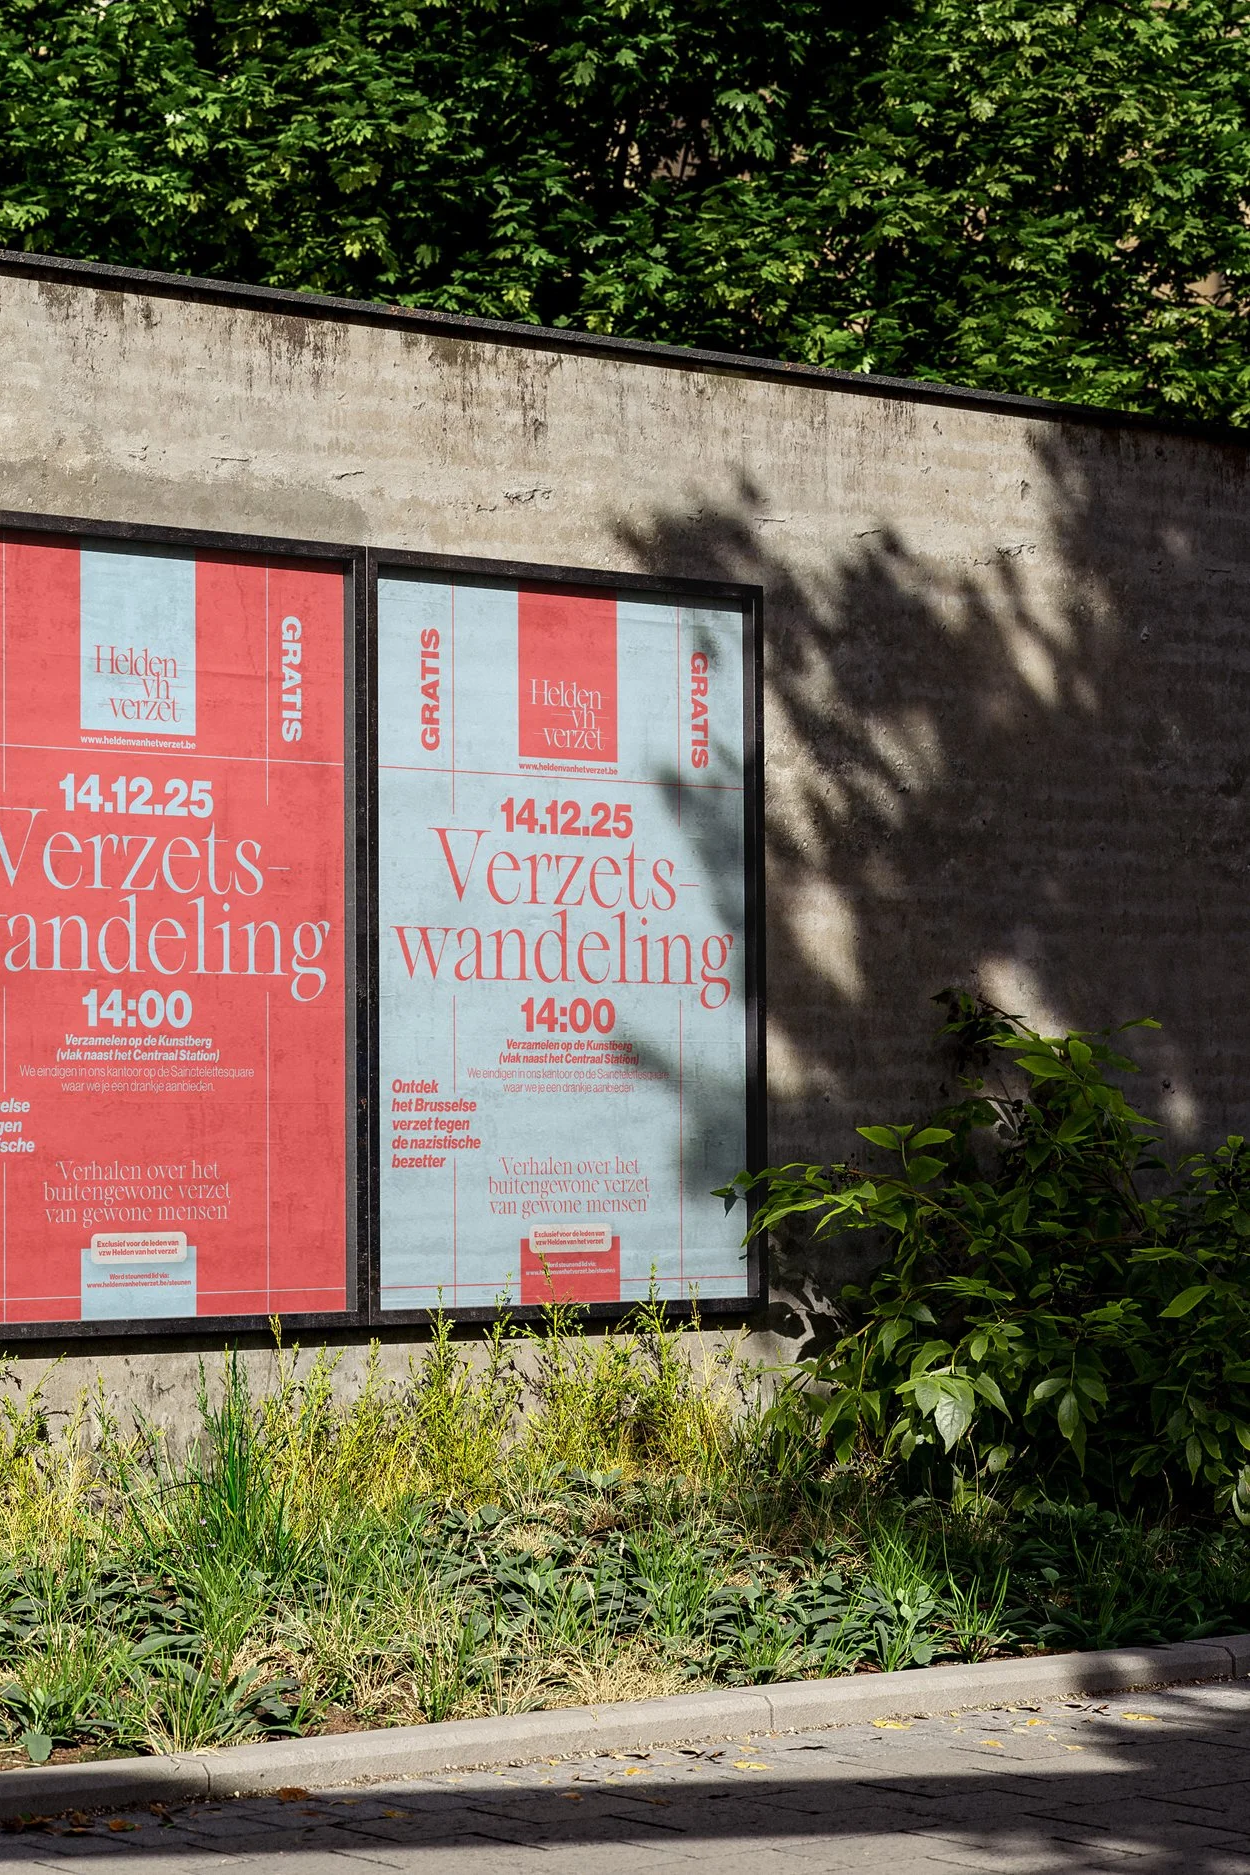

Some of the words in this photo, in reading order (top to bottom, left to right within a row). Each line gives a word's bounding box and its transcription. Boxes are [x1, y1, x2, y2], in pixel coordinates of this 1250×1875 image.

[95, 645, 180, 679] Helden
[281, 615, 303, 743] GRATIS
[420, 627, 440, 751] GRATIS
[531, 679, 604, 710] Helden
[110, 693, 181, 723] verzet
[691, 652, 709, 769] GRATIS
[81, 734, 196, 750] www.heldenvanhetverzet.be
[544, 723, 605, 751] verzet
[519, 761, 618, 776] www.heldenvanhetverzet.be
[60, 774, 213, 818] 14.12.25
[501, 798, 633, 839] 14.12.25
[427, 828, 700, 909] Verzets-
[389, 909, 733, 1009] wandeling
[82, 989, 192, 1028] 14:00
[521, 997, 616, 1034] 14:00
[65, 1034, 127, 1046] Verzamelen
[129, 1037, 143, 1048] op
[144, 1036, 157, 1047] de
[158, 1036, 213, 1049] Kunstberg
[506, 1039, 560, 1050] Verzamelen
[561, 1042, 573, 1052] op
[574, 1041, 585, 1051] de
[586, 1041, 633, 1053] Kunstberg
[56, 1048, 83, 1062] (vlak
[84, 1050, 114, 1060] naast
[115, 1049, 132, 1061] het
[133, 1049, 178, 1061] Centraal
[179, 1050, 220, 1063] Station)
[499, 1052, 522, 1065] (vlak
[523, 1054, 548, 1064] naast
[549, 1053, 564, 1064] het
[565, 1053, 604, 1064] Centraal
[605, 1054, 640, 1066] Station)
[391, 1079, 438, 1094] Ontdek
[391, 1099, 412, 1112] het
[414, 1098, 476, 1112] Brusselse
[391, 1118, 432, 1130] verzet
[434, 1118, 470, 1134] tegen
[391, 1136, 408, 1150] de
[409, 1135, 480, 1150] nazistische
[148, 1164, 187, 1180] over
[192, 1160, 220, 1180] het
[391, 1155, 446, 1169] bezetter
[578, 1161, 611, 1175] over
[616, 1156, 641, 1175] het
[43, 1180, 173, 1208] buitengewone
[179, 1181, 231, 1200] verzet
[488, 1176, 600, 1201] buitengewone
[604, 1176, 650, 1194] verzet
[46, 1208, 77, 1224] van
[83, 1206, 152, 1229] gewone
[490, 1201, 517, 1216] van
[522, 1200, 581, 1220] gewone
